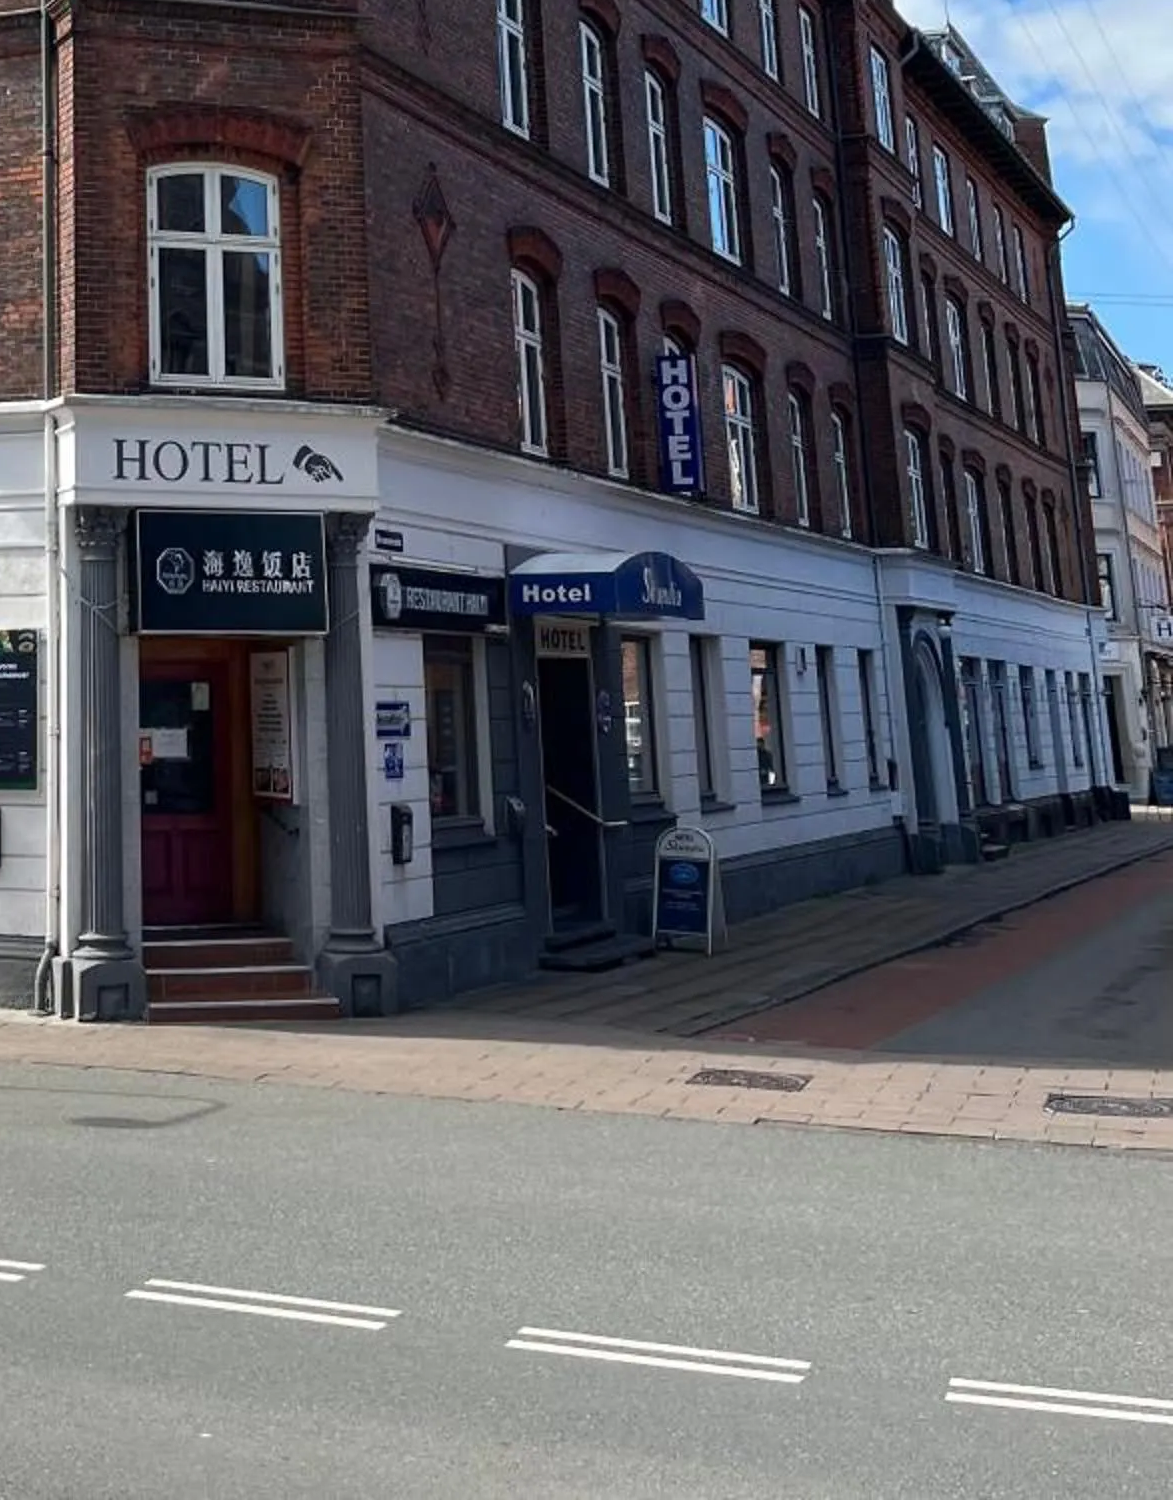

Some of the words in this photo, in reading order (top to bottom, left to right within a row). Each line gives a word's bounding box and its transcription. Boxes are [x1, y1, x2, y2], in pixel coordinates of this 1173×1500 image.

[660, 359, 695, 485] HOTEL
[113, 438, 285, 485] HOTEL
[202, 579, 235, 593] HAIYI
[237, 579, 315, 594] RESTAURANT
[522, 583, 593, 603] Hotel
[541, 627, 586, 651] HOTEL
